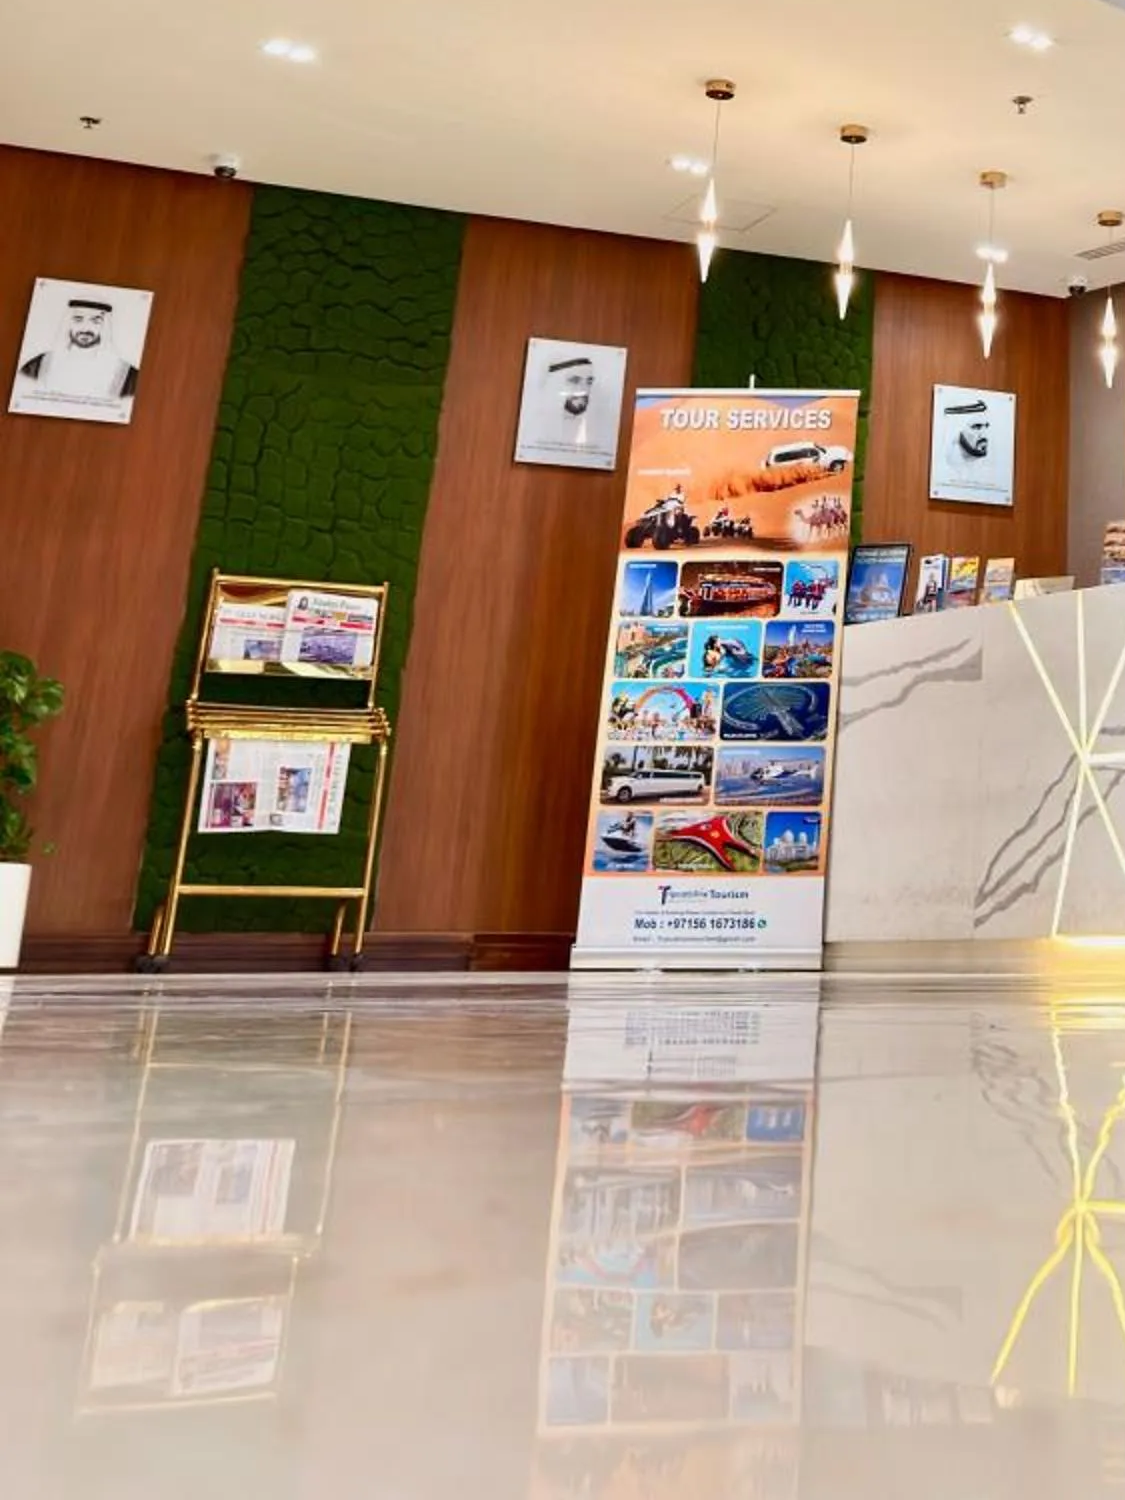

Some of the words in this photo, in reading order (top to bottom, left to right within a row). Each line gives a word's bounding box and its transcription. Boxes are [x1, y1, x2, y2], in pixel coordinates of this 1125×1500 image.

[661, 408, 720, 429] TOUR
[726, 408, 832, 429] SERVICES
[710, 889, 749, 899] Tourism
[634, 918, 657, 929] Mob
